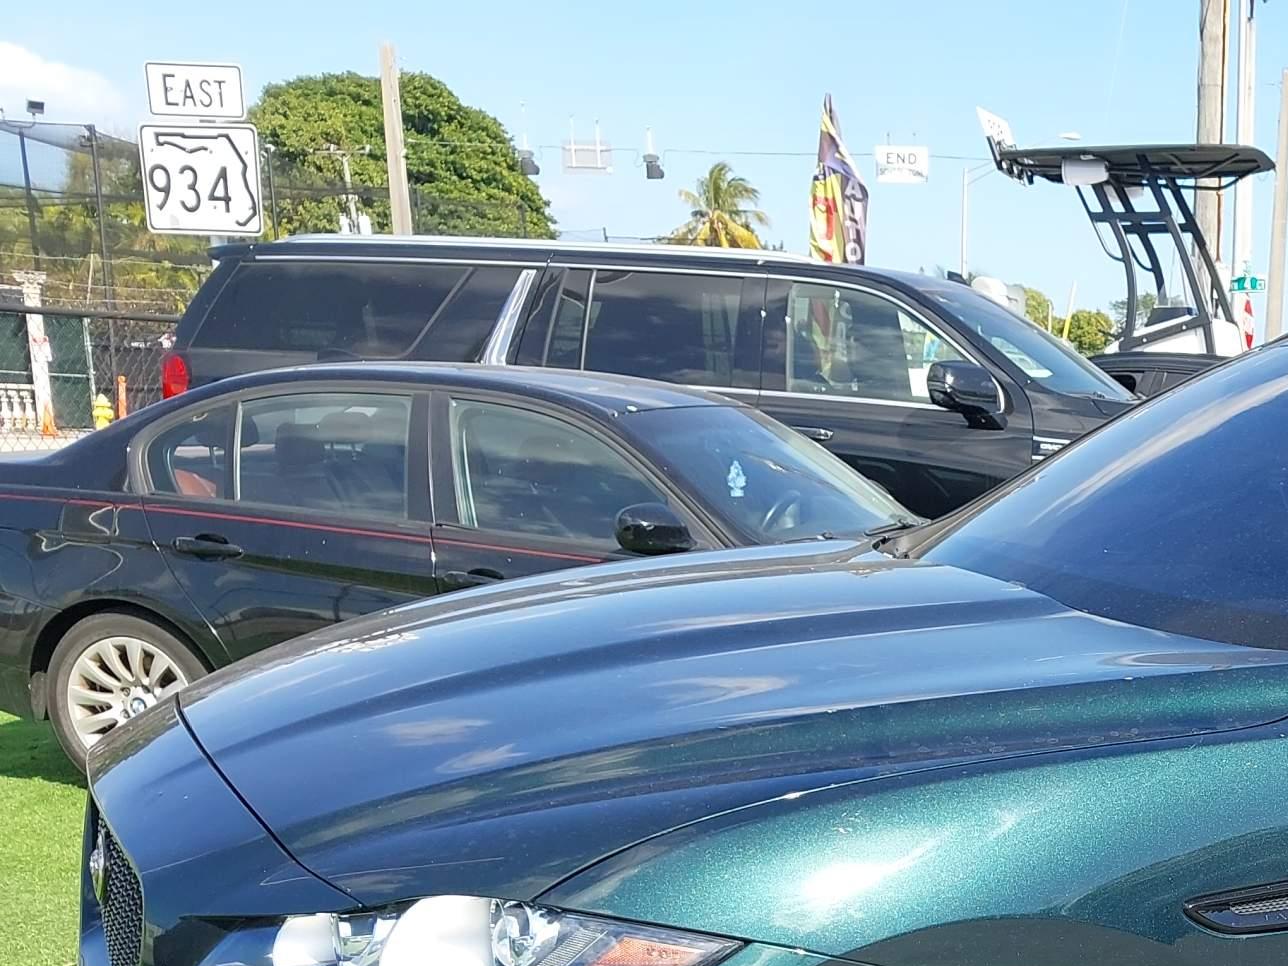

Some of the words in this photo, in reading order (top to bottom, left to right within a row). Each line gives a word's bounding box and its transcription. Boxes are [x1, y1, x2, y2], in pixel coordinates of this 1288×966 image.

[162, 73, 226, 108] EAST
[886, 152, 917, 165] END
[149, 164, 232, 213] 934
